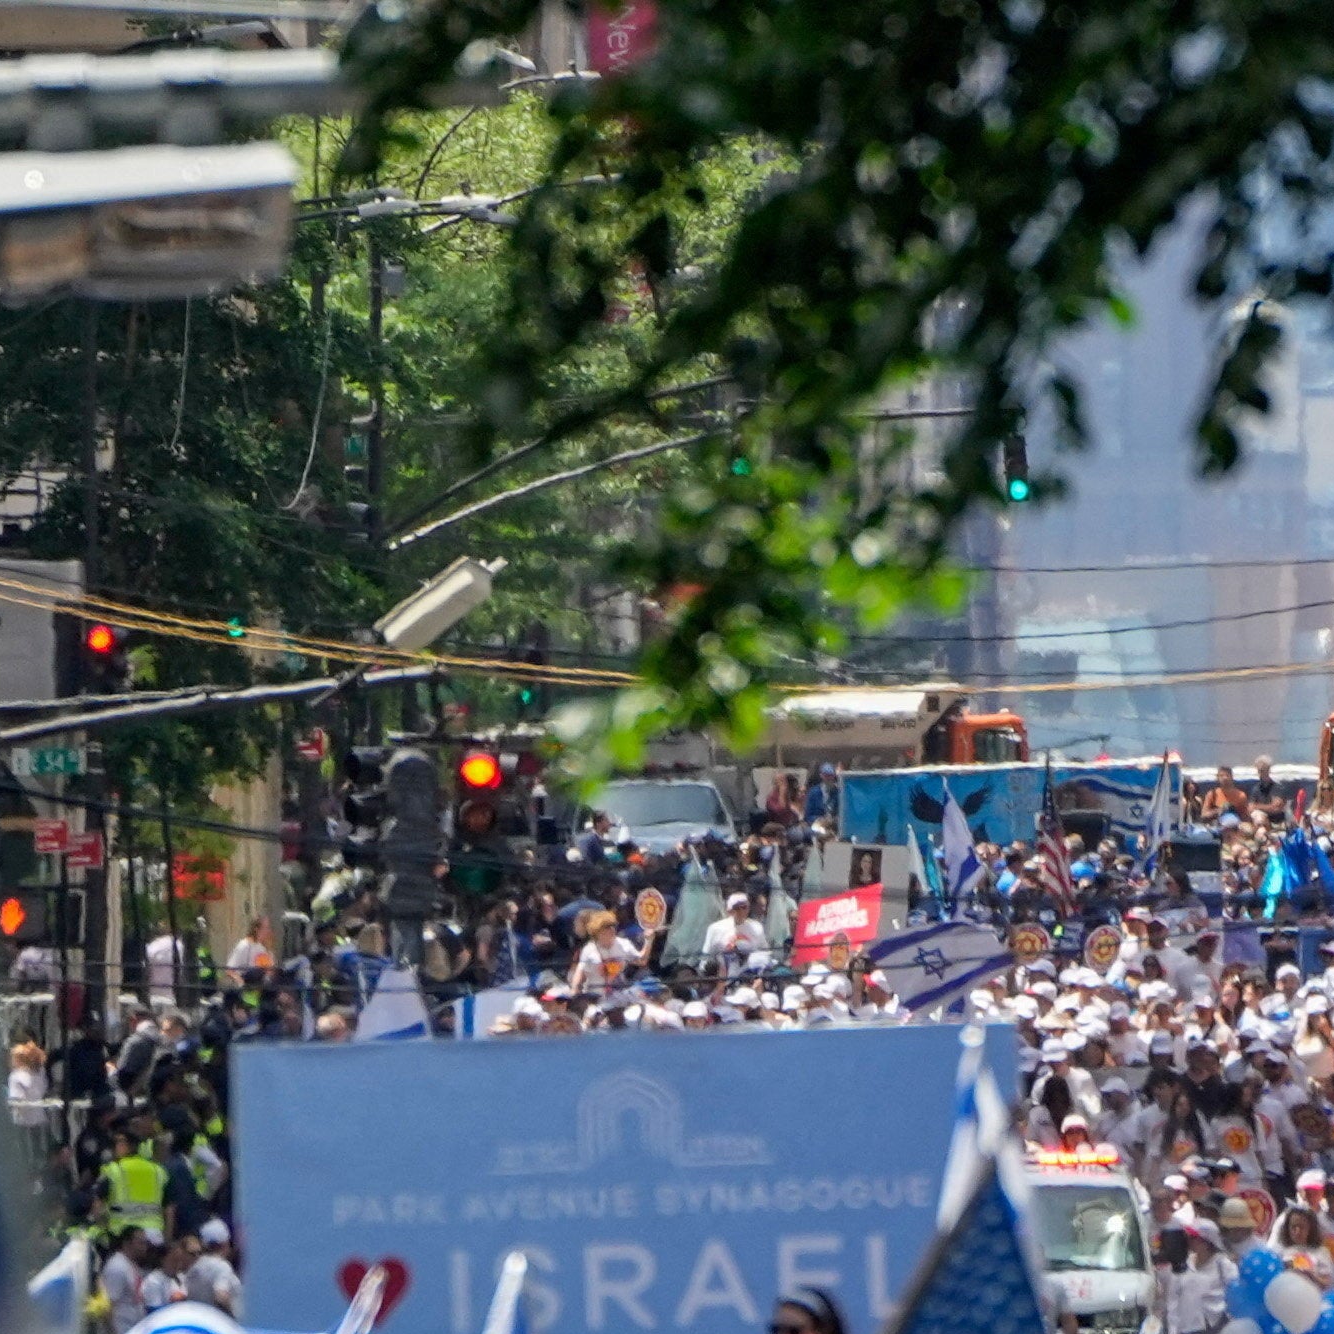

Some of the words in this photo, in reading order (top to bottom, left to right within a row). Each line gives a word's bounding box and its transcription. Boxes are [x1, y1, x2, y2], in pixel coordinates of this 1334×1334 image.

[332, 1195, 445, 1227] PARK
[462, 1186, 640, 1221] AVENUE
[655, 1174, 932, 1215] SYNAGOGUE
